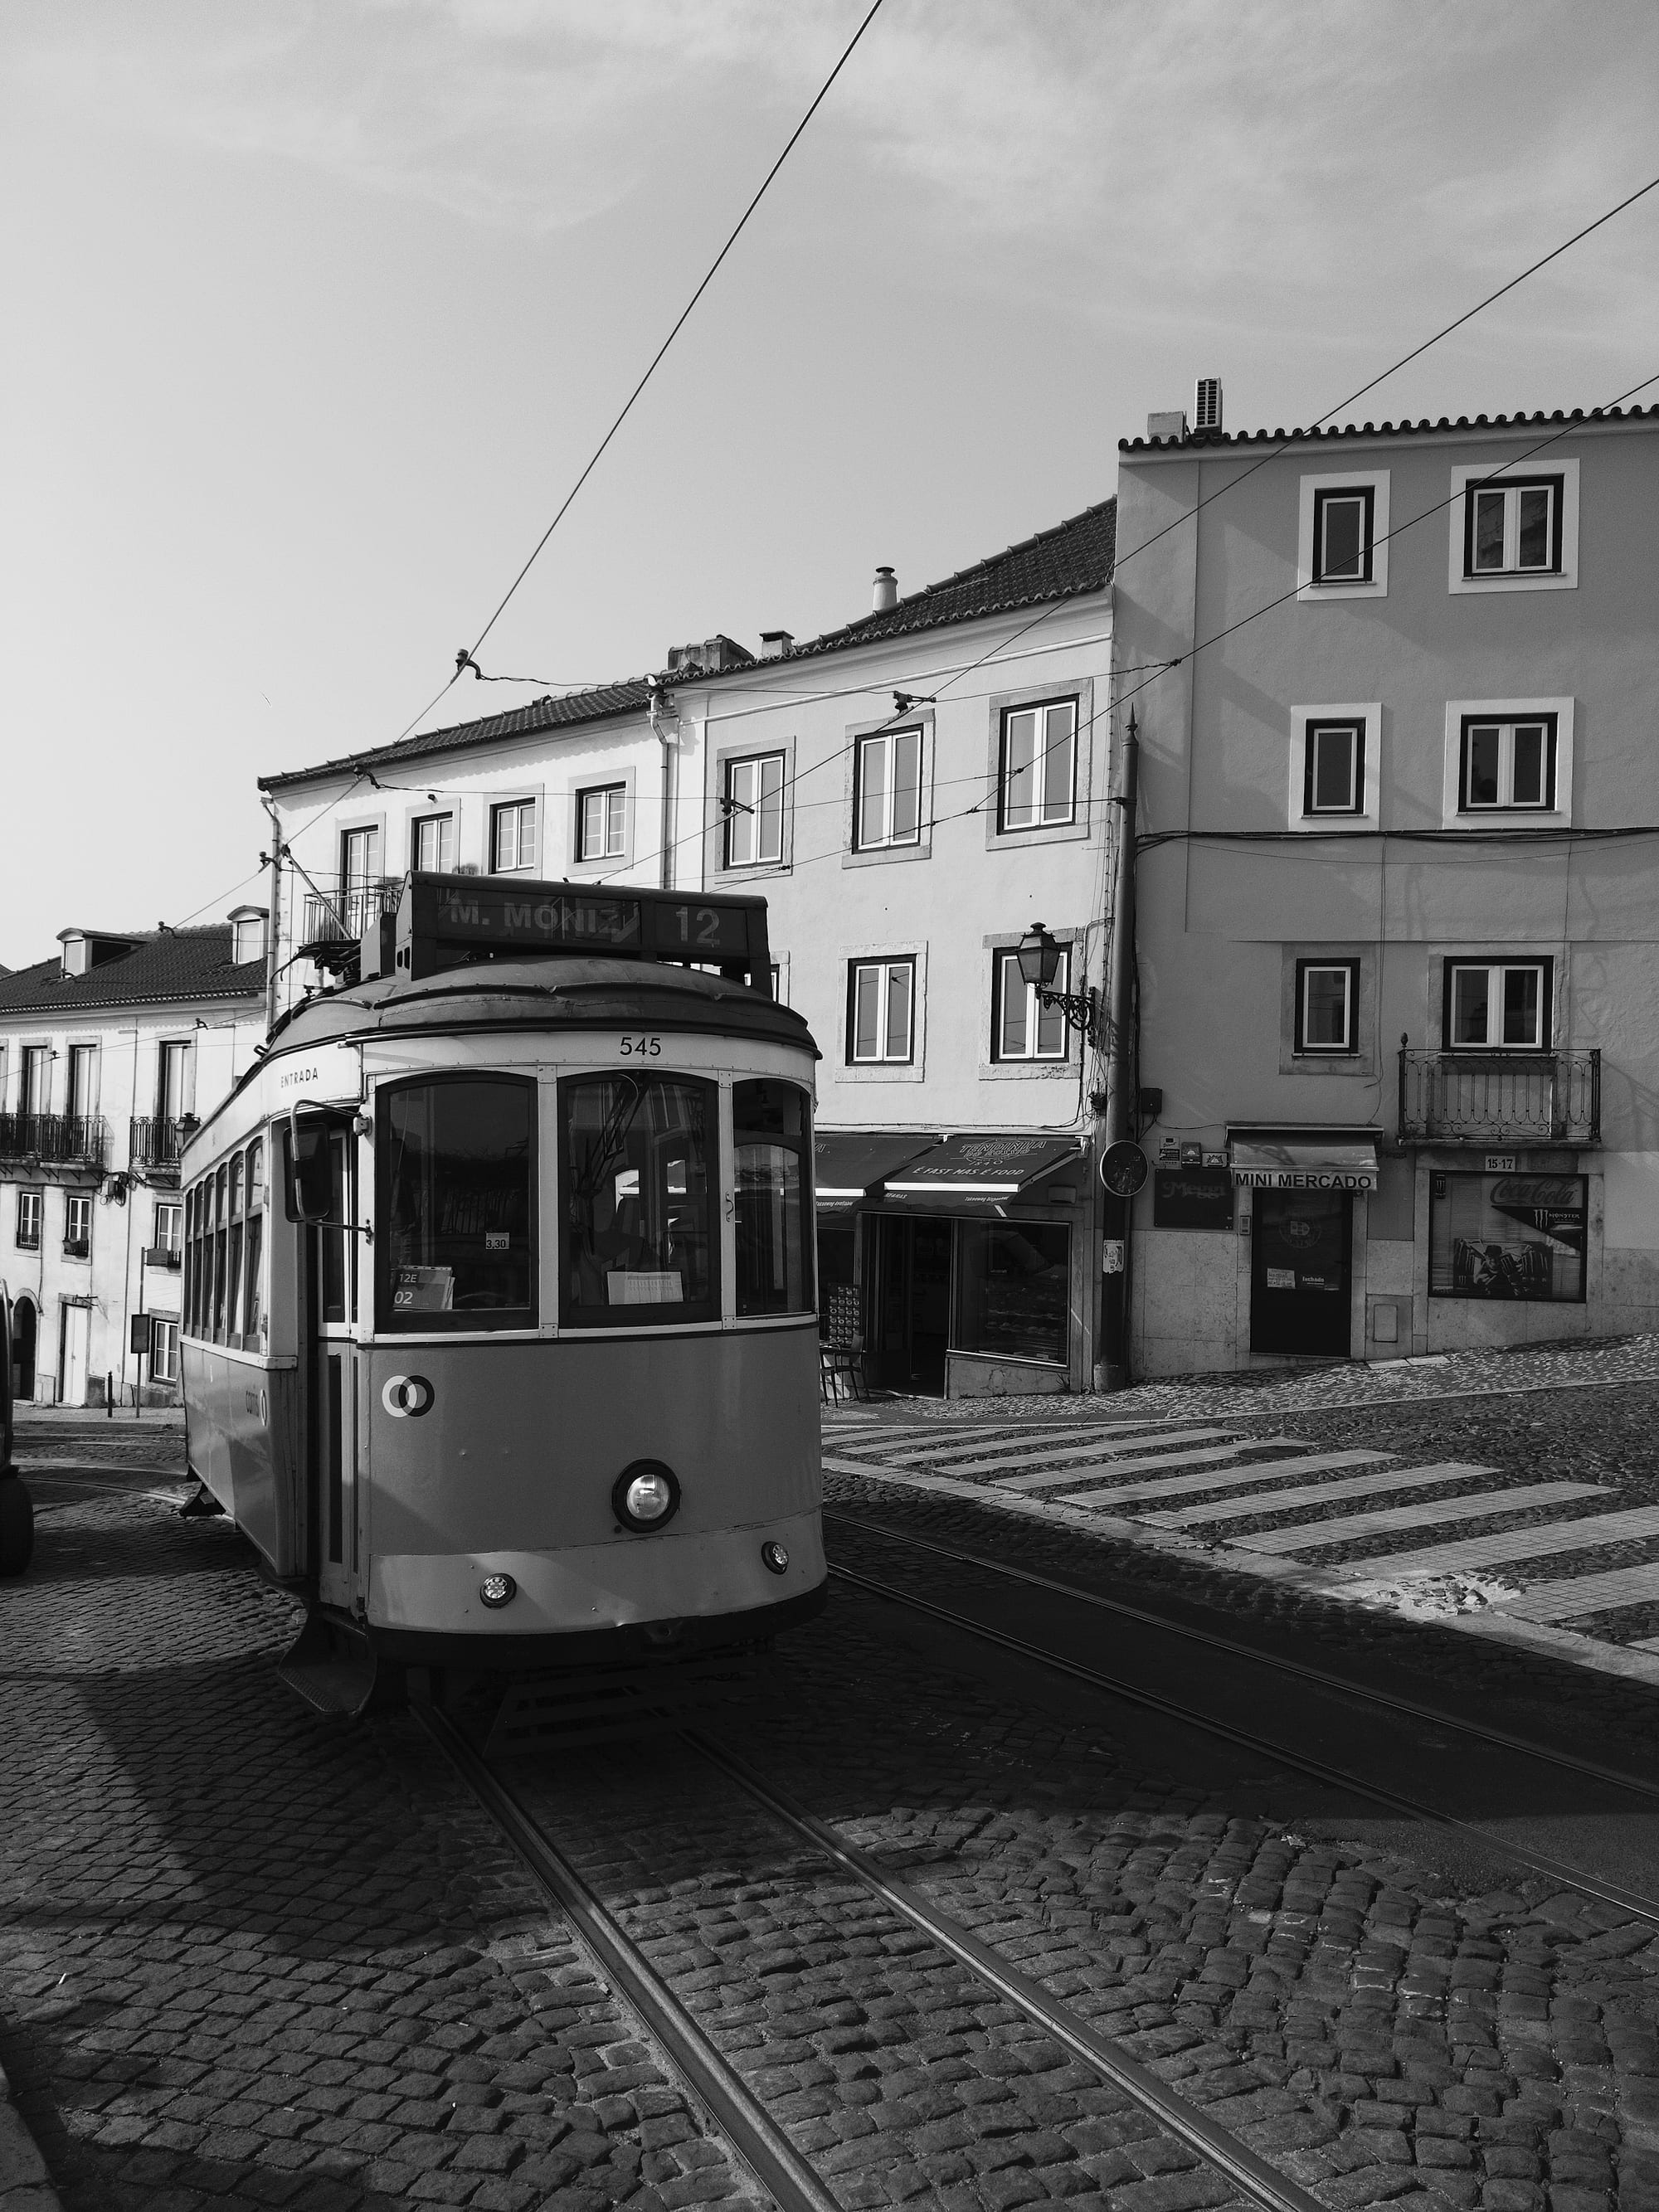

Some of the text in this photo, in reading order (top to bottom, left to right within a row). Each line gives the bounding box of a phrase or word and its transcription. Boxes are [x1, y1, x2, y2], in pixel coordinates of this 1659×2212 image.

[451, 897, 624, 935] M. MONIZ
[675, 907, 721, 946] 12
[620, 1037, 661, 1056] 545
[280, 1067, 319, 1088] ENTRADA
[1487, 1158, 1513, 1169] 15-17
[1235, 1173, 1372, 1189] MINI MERCADO
[399, 1273, 418, 1283] 12E
[394, 1291, 413, 1305] 02
